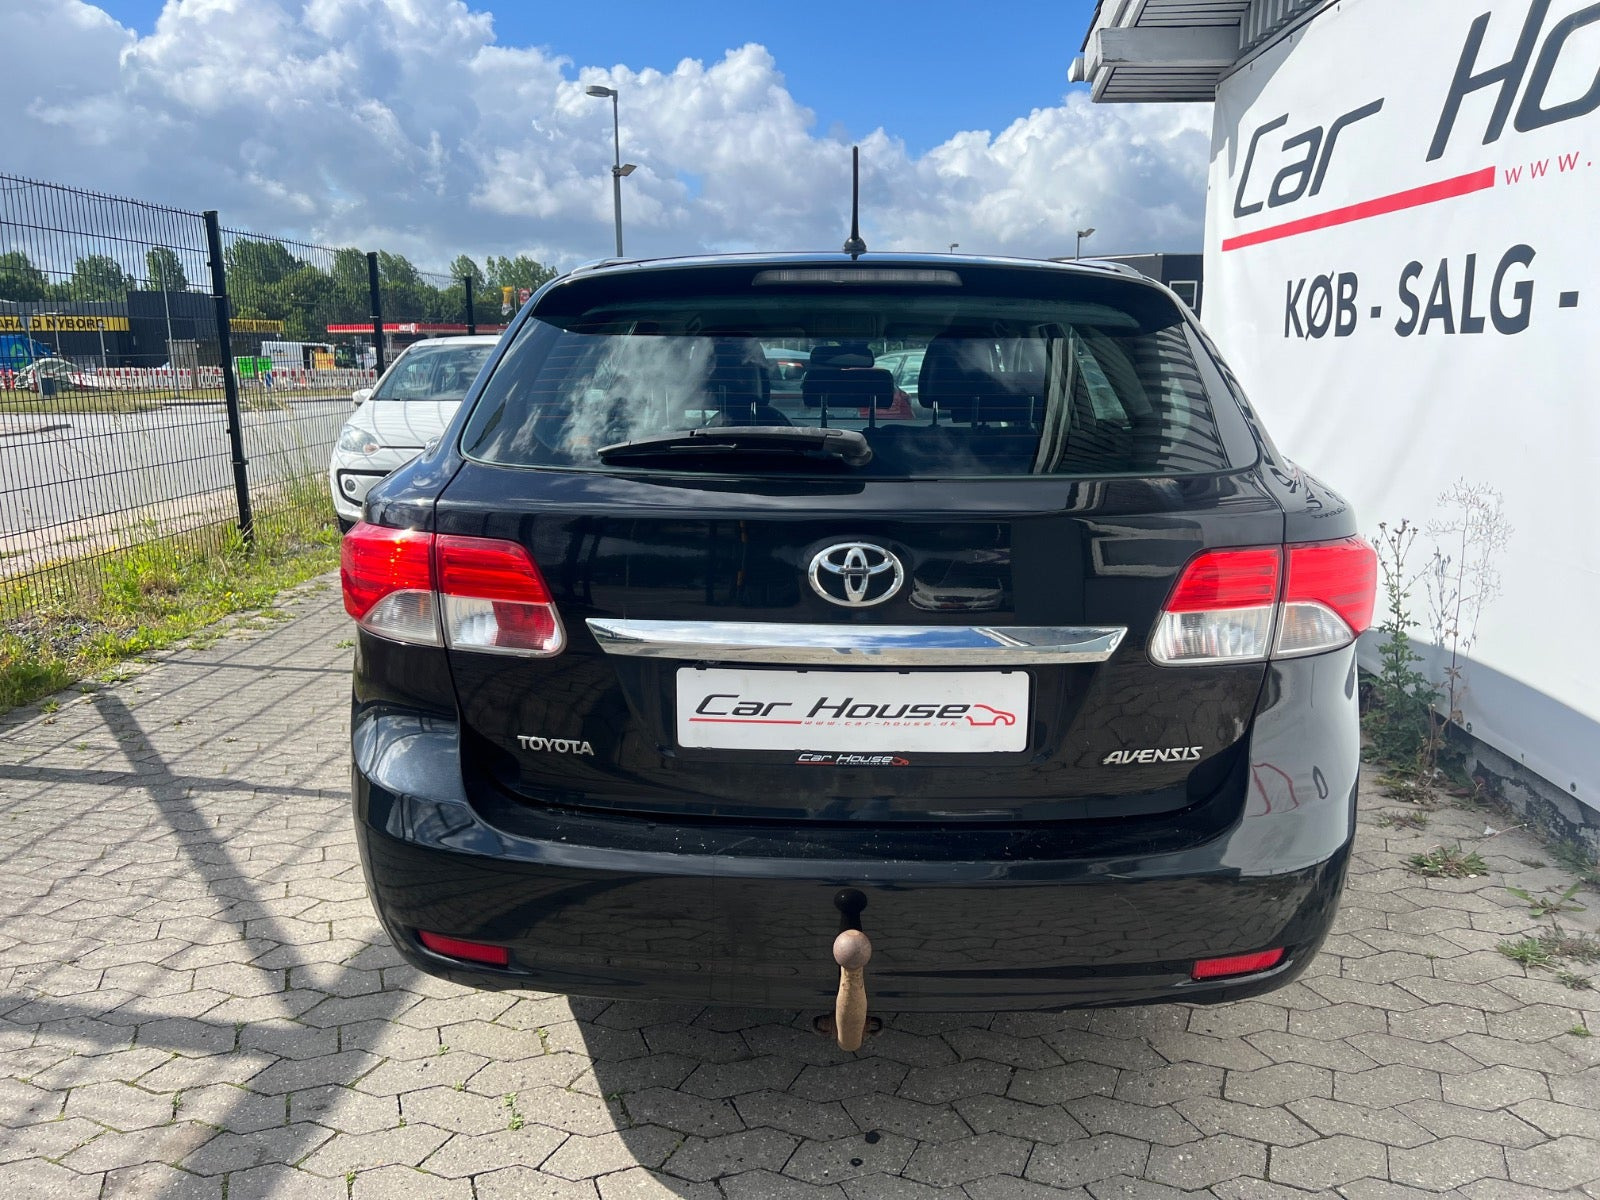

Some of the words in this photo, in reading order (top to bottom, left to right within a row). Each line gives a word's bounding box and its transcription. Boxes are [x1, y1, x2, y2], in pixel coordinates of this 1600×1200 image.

[1233, 97, 1385, 219] Car
[1284, 271, 1359, 341] KØB
[1394, 243, 1537, 338] SALG
[695, 694, 793, 717] Car
[806, 697, 971, 719] House
[517, 735, 595, 756] TOYOTA
[1103, 746, 1203, 765] AVENSIS
[798, 753, 832, 762] Car
[835, 754, 893, 763] House
